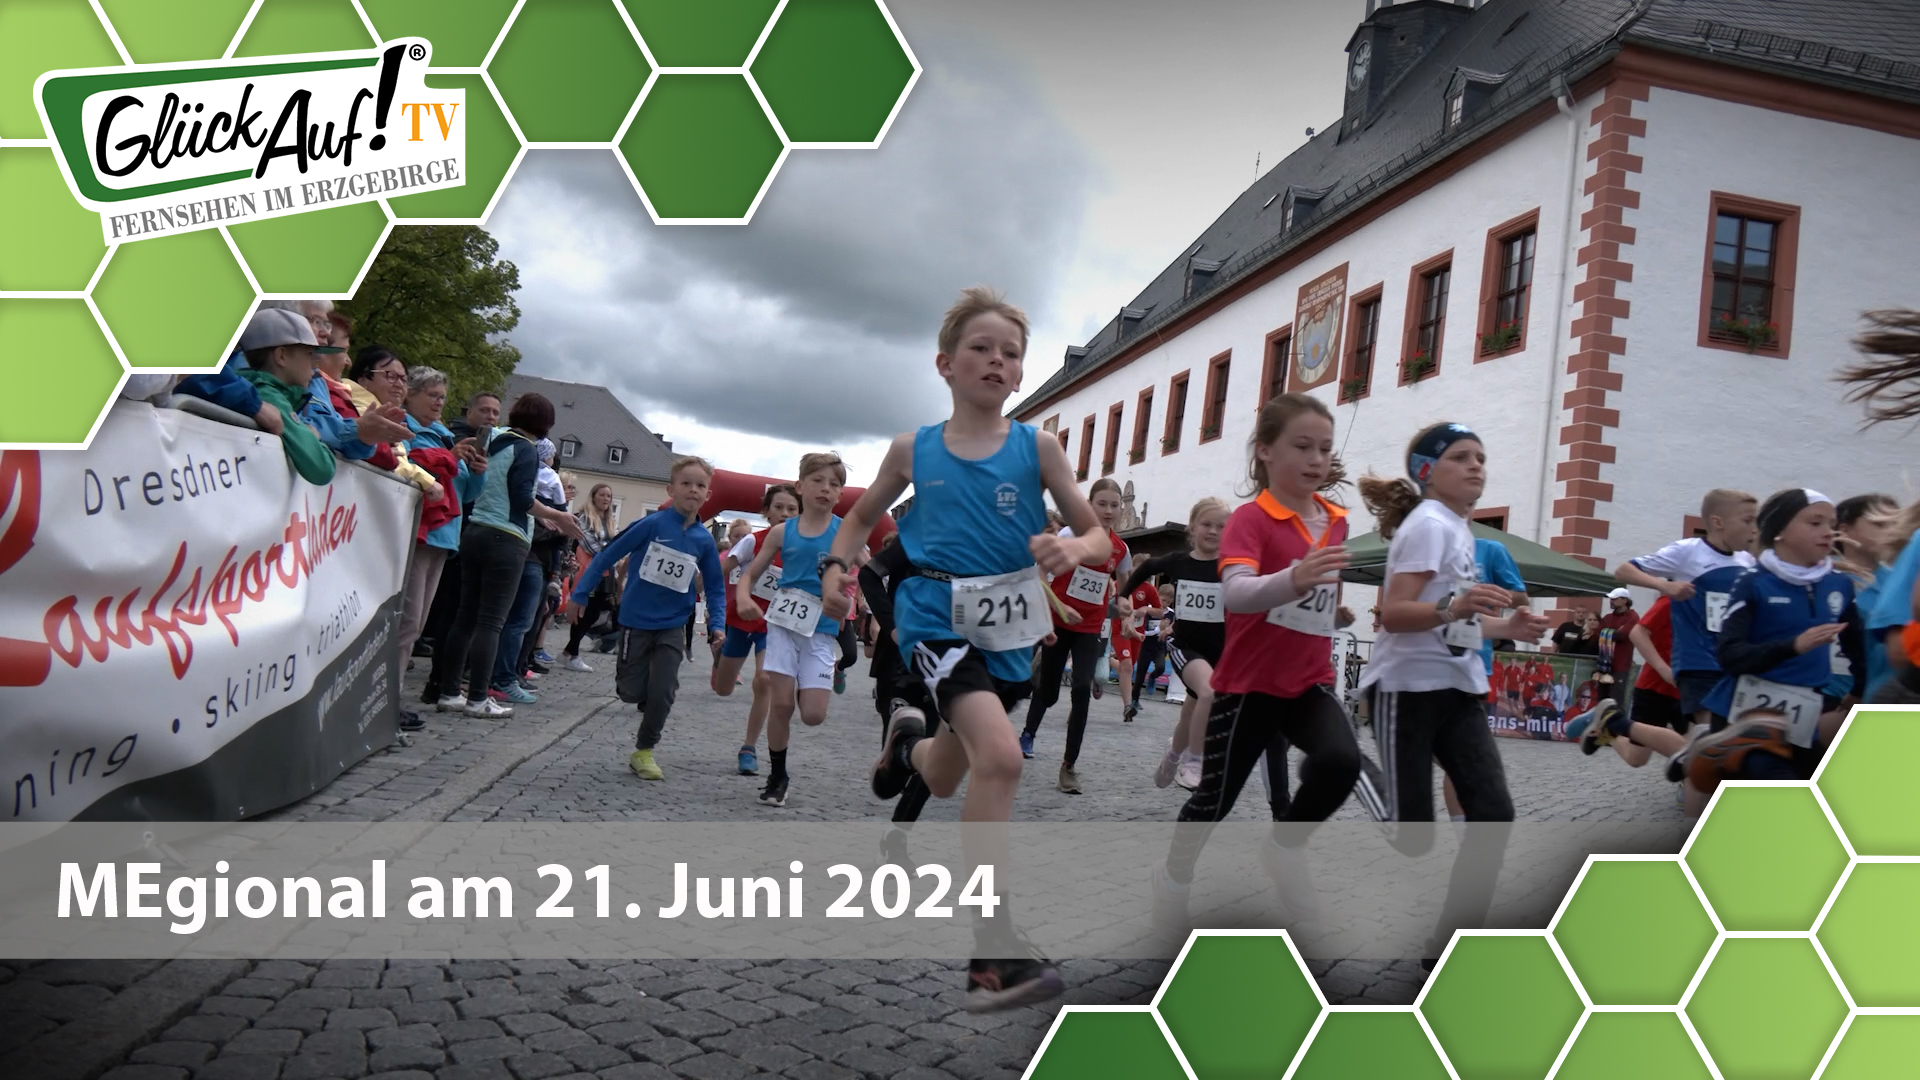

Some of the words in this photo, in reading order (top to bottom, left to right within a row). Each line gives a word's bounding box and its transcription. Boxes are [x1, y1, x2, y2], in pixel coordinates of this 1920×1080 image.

[84, 455, 247, 516] Dresdner
[656, 558, 685, 579] 133
[1079, 578, 1103, 594] 233
[777, 598, 809, 620] 213
[977, 593, 1028, 627] 211
[1185, 592, 1216, 610] 205
[1296, 586, 1335, 614] 201
[205, 653, 296, 728] skiing
[317, 589, 362, 655] triathlon
